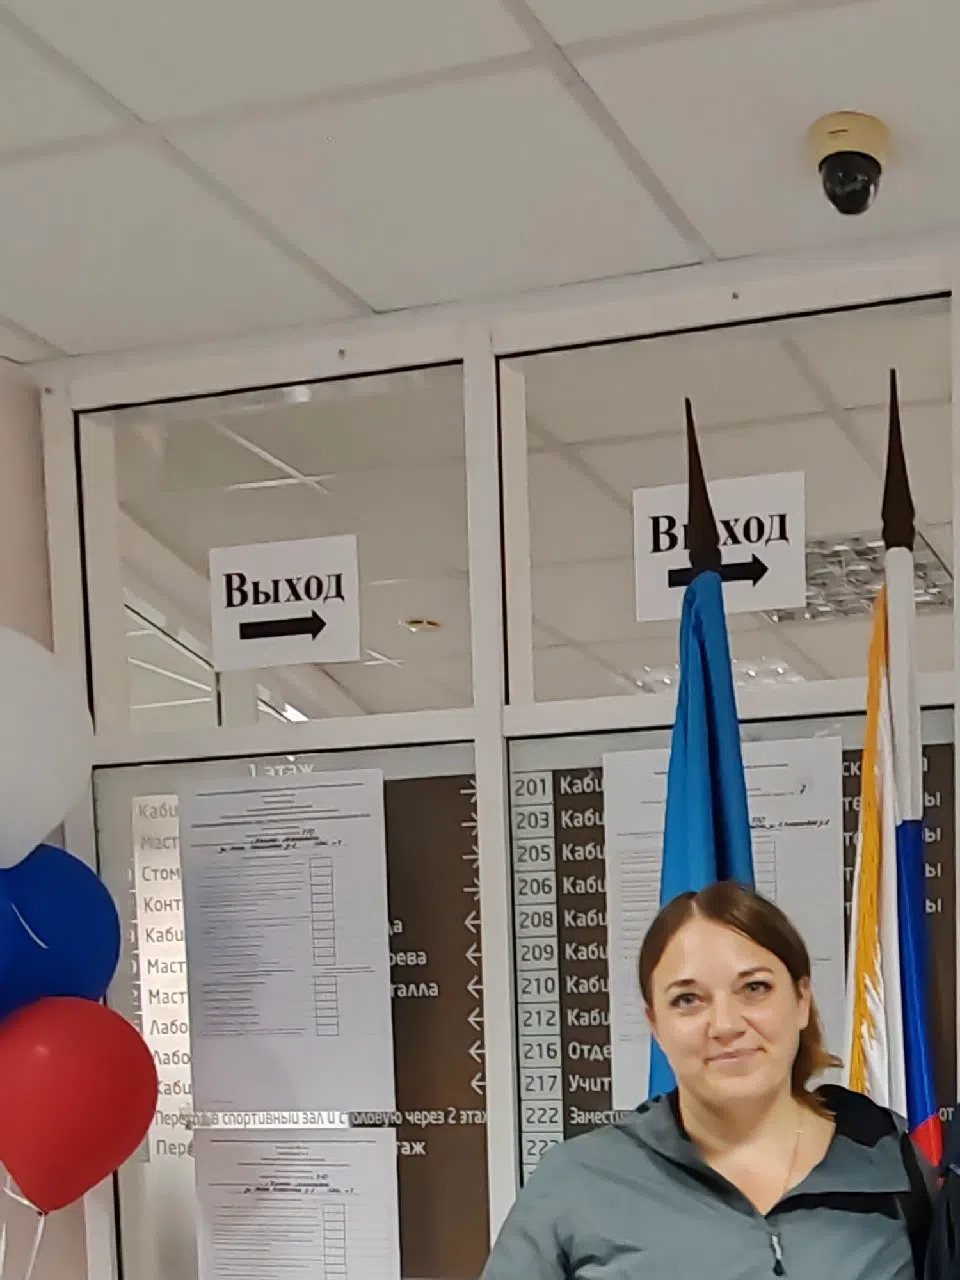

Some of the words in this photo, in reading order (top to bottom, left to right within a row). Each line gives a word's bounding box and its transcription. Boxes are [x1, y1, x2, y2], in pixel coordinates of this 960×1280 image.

[649, 513, 790, 553] Вход
[223, 569, 345, 609] Выход
[515, 778, 547, 796] 201
[559, 775, 604, 794] Каби
[138, 802, 179, 820] Каби
[516, 811, 549, 829] 203
[560, 808, 605, 828] Каби
[140, 836, 179, 850] Маст
[516, 845, 551, 862] 205
[562, 842, 605, 862] Каби
[142, 866, 180, 881] Стом
[518, 878, 552, 896] 206
[562, 876, 607, 894] Каби
[144, 897, 182, 912] Конт
[519, 911, 554, 929] 208
[563, 909, 608, 927] Каби
[146, 927, 184, 943] Каби
[520, 944, 555, 961] 209
[564, 942, 609, 960] Каби
[147, 959, 186, 974] Маст
[148, 989, 186, 1004] Маст
[390, 982, 439, 998] талла
[521, 977, 556, 995] 210
[565, 975, 610, 993] Каби
[150, 1019, 189, 1035] Лабо
[523, 1010, 557, 1027] 212
[566, 1008, 611, 1026] Каби
[154, 1050, 191, 1065] Лабо
[523, 1043, 558, 1060] 216
[567, 1041, 612, 1061] Отде
[157, 1080, 192, 1095] Каби
[524, 1075, 558, 1092] 217
[568, 1074, 611, 1092] Учит
[405, 1110, 445, 1128] через
[447, 1107, 457, 1123] 2
[526, 1107, 559, 1124] 222
[568, 1106, 624, 1125] Замести
[156, 1139, 195, 1157] Пере
[527, 1140, 559, 1156] 22
